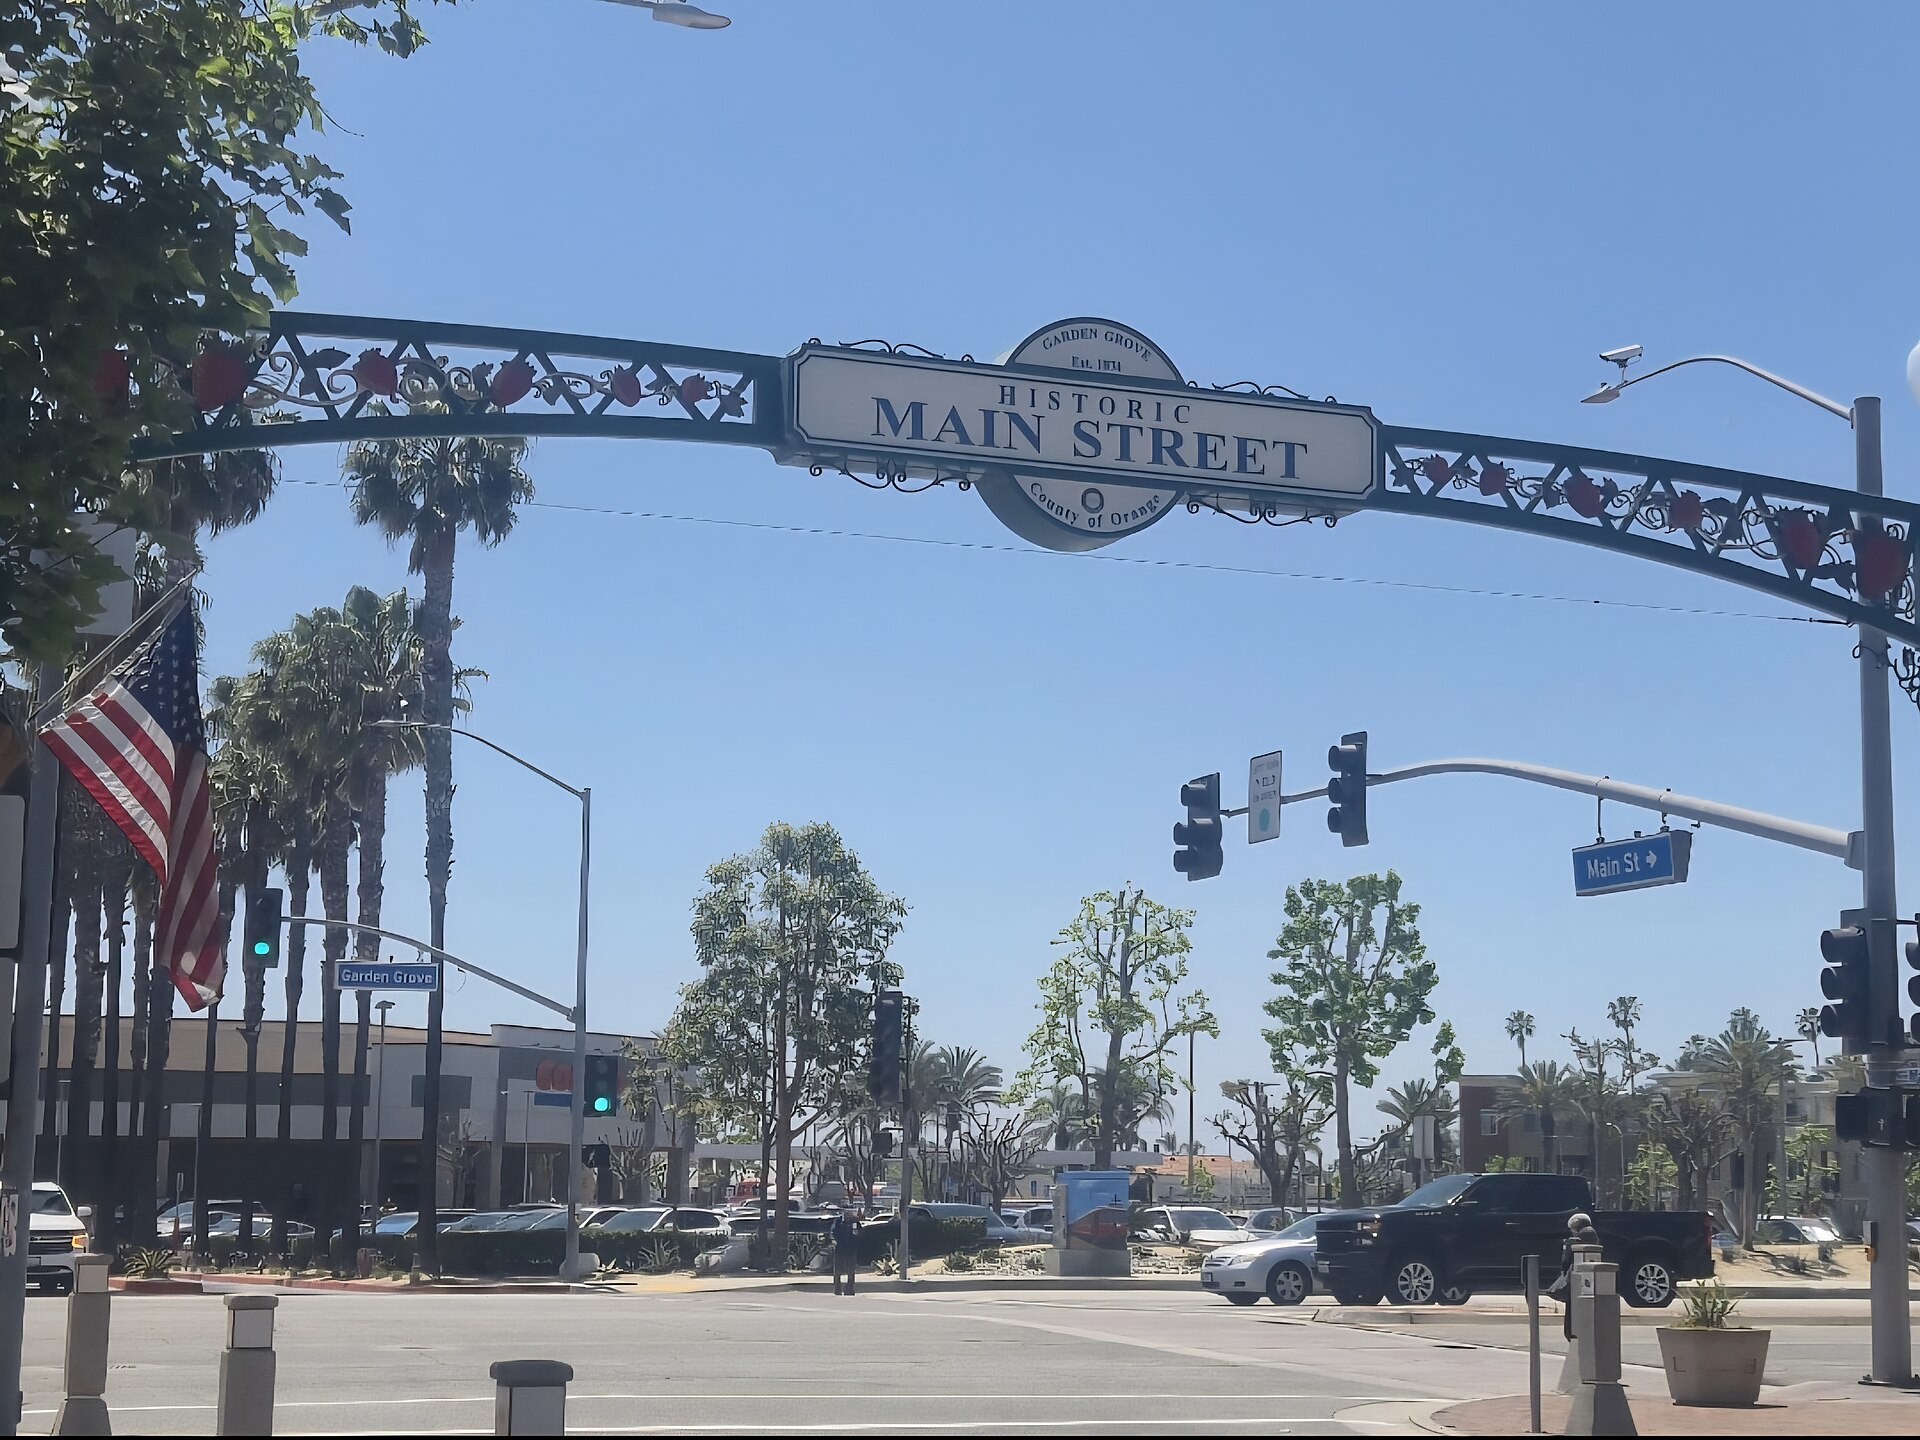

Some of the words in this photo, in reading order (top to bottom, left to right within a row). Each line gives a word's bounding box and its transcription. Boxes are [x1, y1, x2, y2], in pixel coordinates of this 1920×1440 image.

[1043, 328, 1098, 350] GARDEN
[1104, 331, 1151, 362] GROVE
[998, 384, 1190, 424] HISTORIC
[871, 396, 1045, 454] MAIN
[1073, 420, 1308, 479] STREET
[1030, 482, 1080, 525] County
[1088, 515, 1103, 528] of
[1111, 494, 1160, 526] Orange
[1587, 857, 1620, 880] Main
[1623, 852, 1641, 873] St
[341, 969, 389, 984] Garden
[393, 970, 433, 984] Grove
